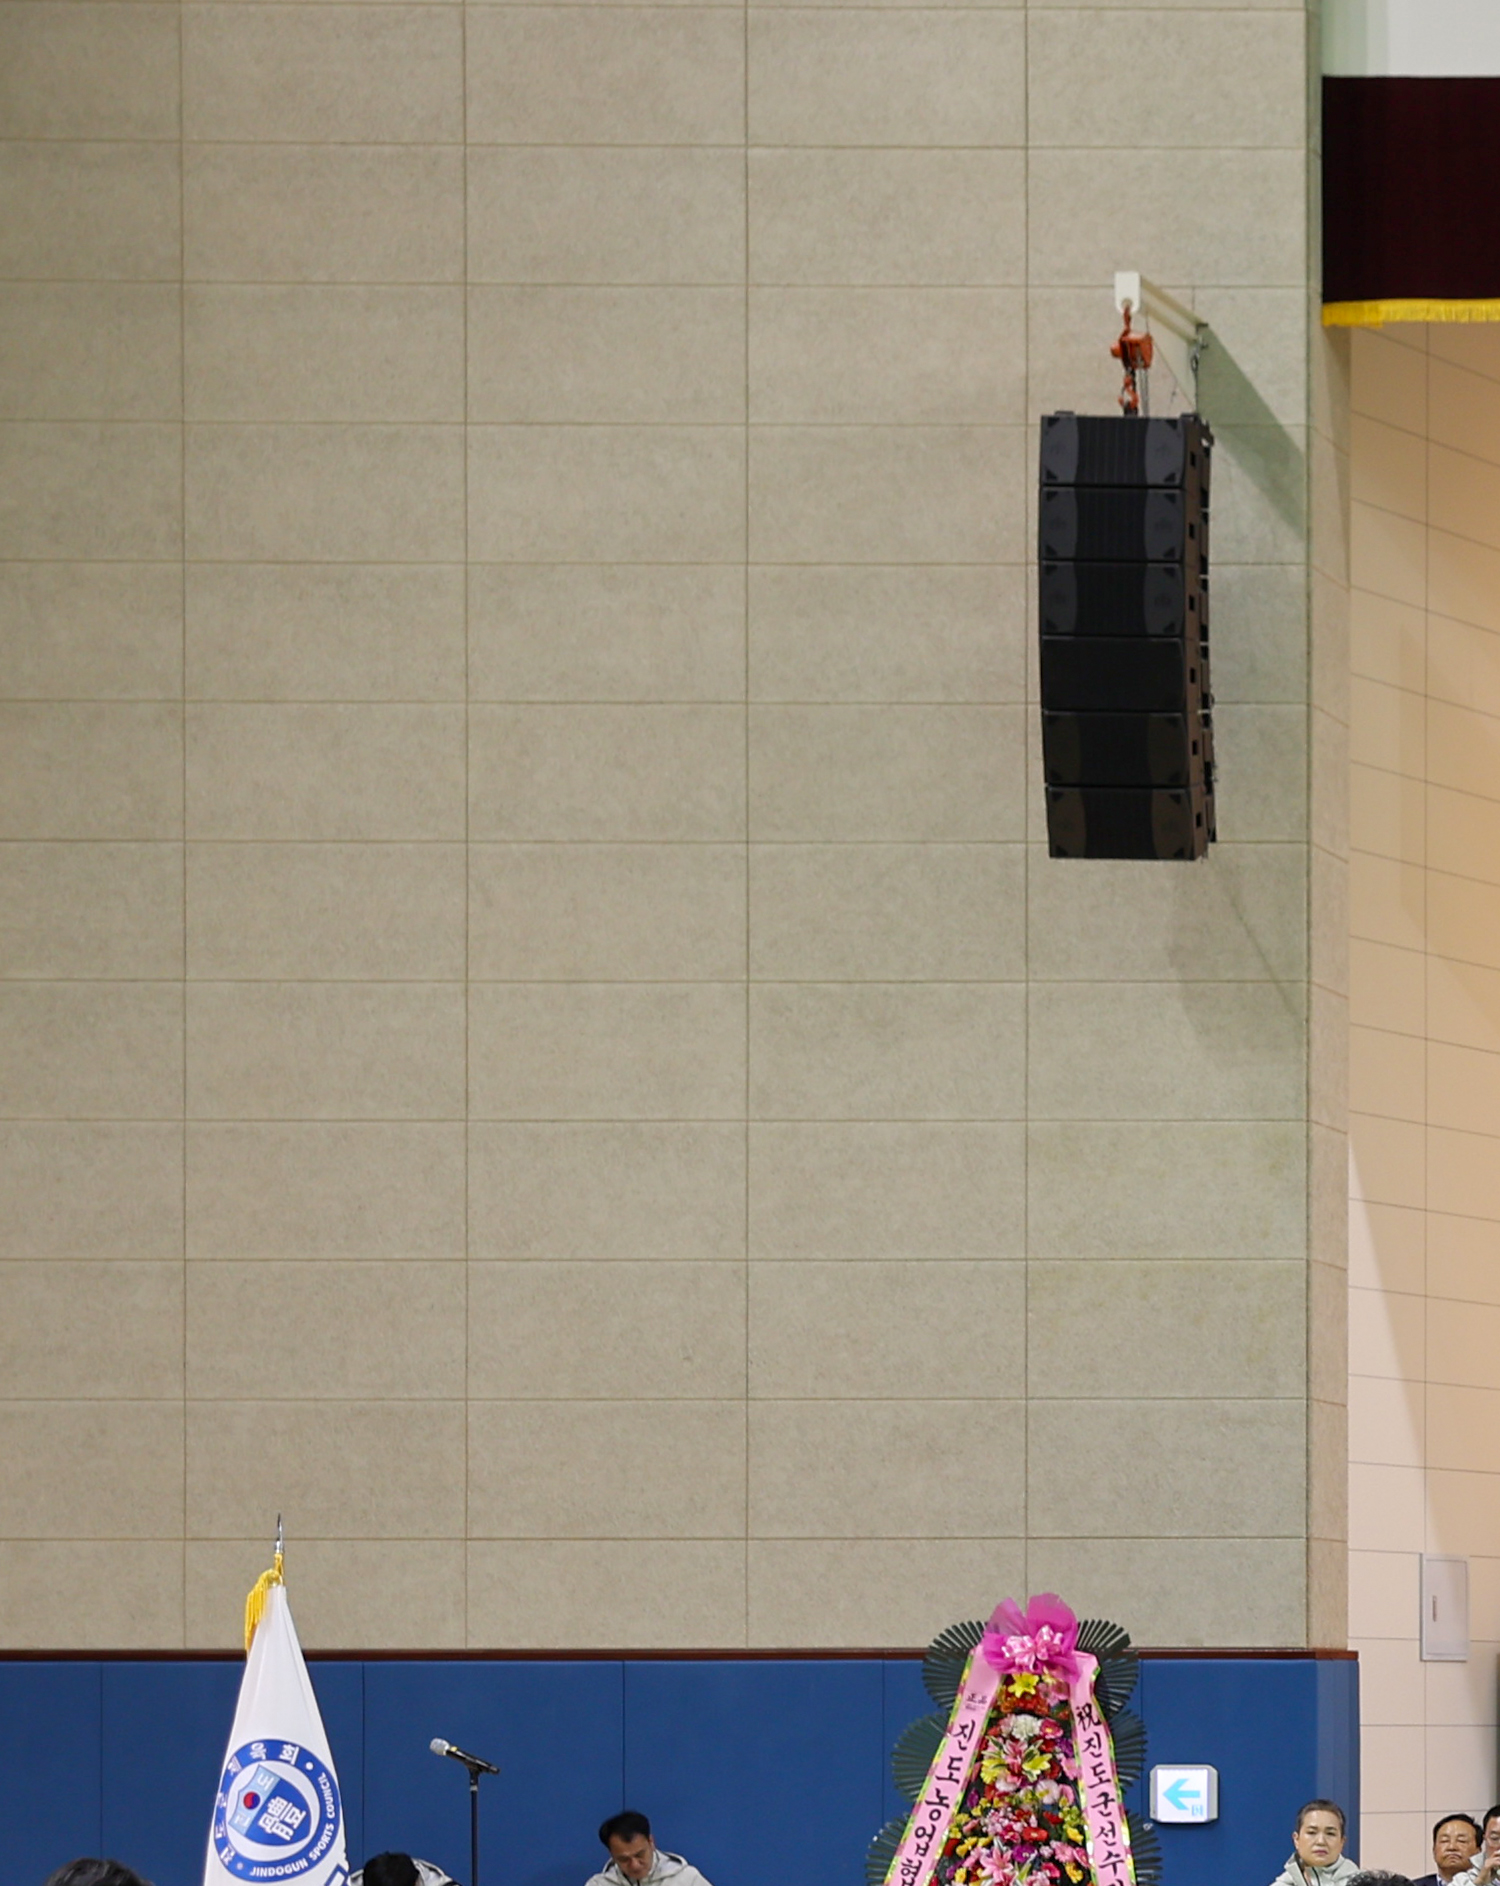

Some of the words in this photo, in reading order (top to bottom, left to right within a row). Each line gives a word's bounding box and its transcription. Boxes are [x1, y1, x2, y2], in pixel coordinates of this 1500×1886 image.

[316, 1771, 336, 1819] COUNCIL
[308, 1822, 335, 1861] SPORTS
[249, 1857, 309, 1878] JINDOGUN
